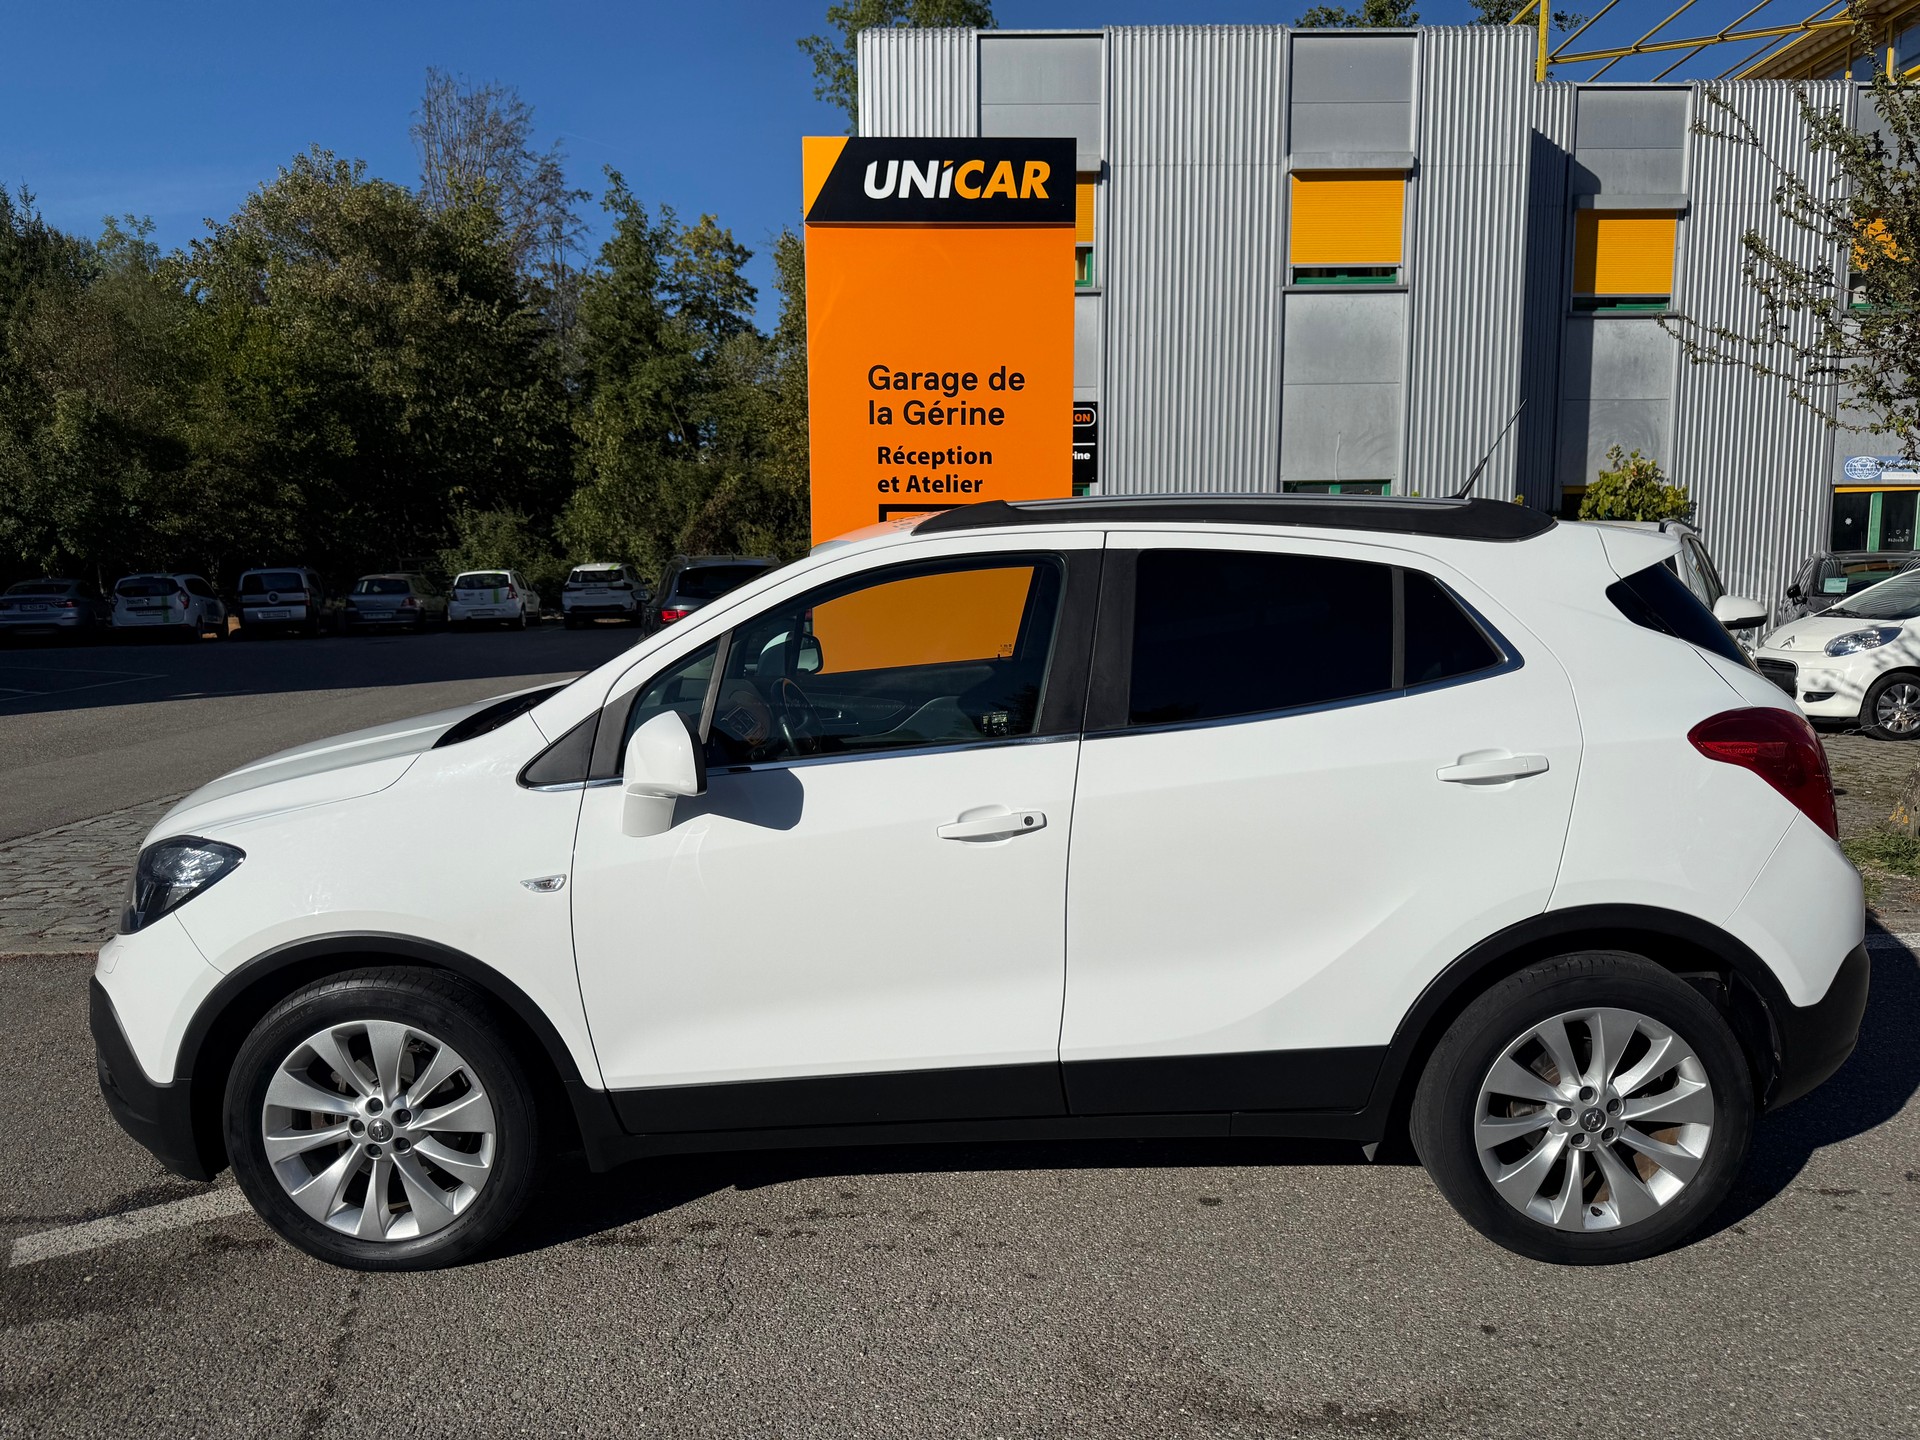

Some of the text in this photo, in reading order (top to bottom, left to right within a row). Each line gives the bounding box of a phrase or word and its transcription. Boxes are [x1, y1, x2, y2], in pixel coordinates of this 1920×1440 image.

[867, 364, 1025, 397] Garage de
[868, 400, 1005, 426] la Gérine
[877, 446, 993, 470] Réception
[877, 474, 983, 493] et Atelier
